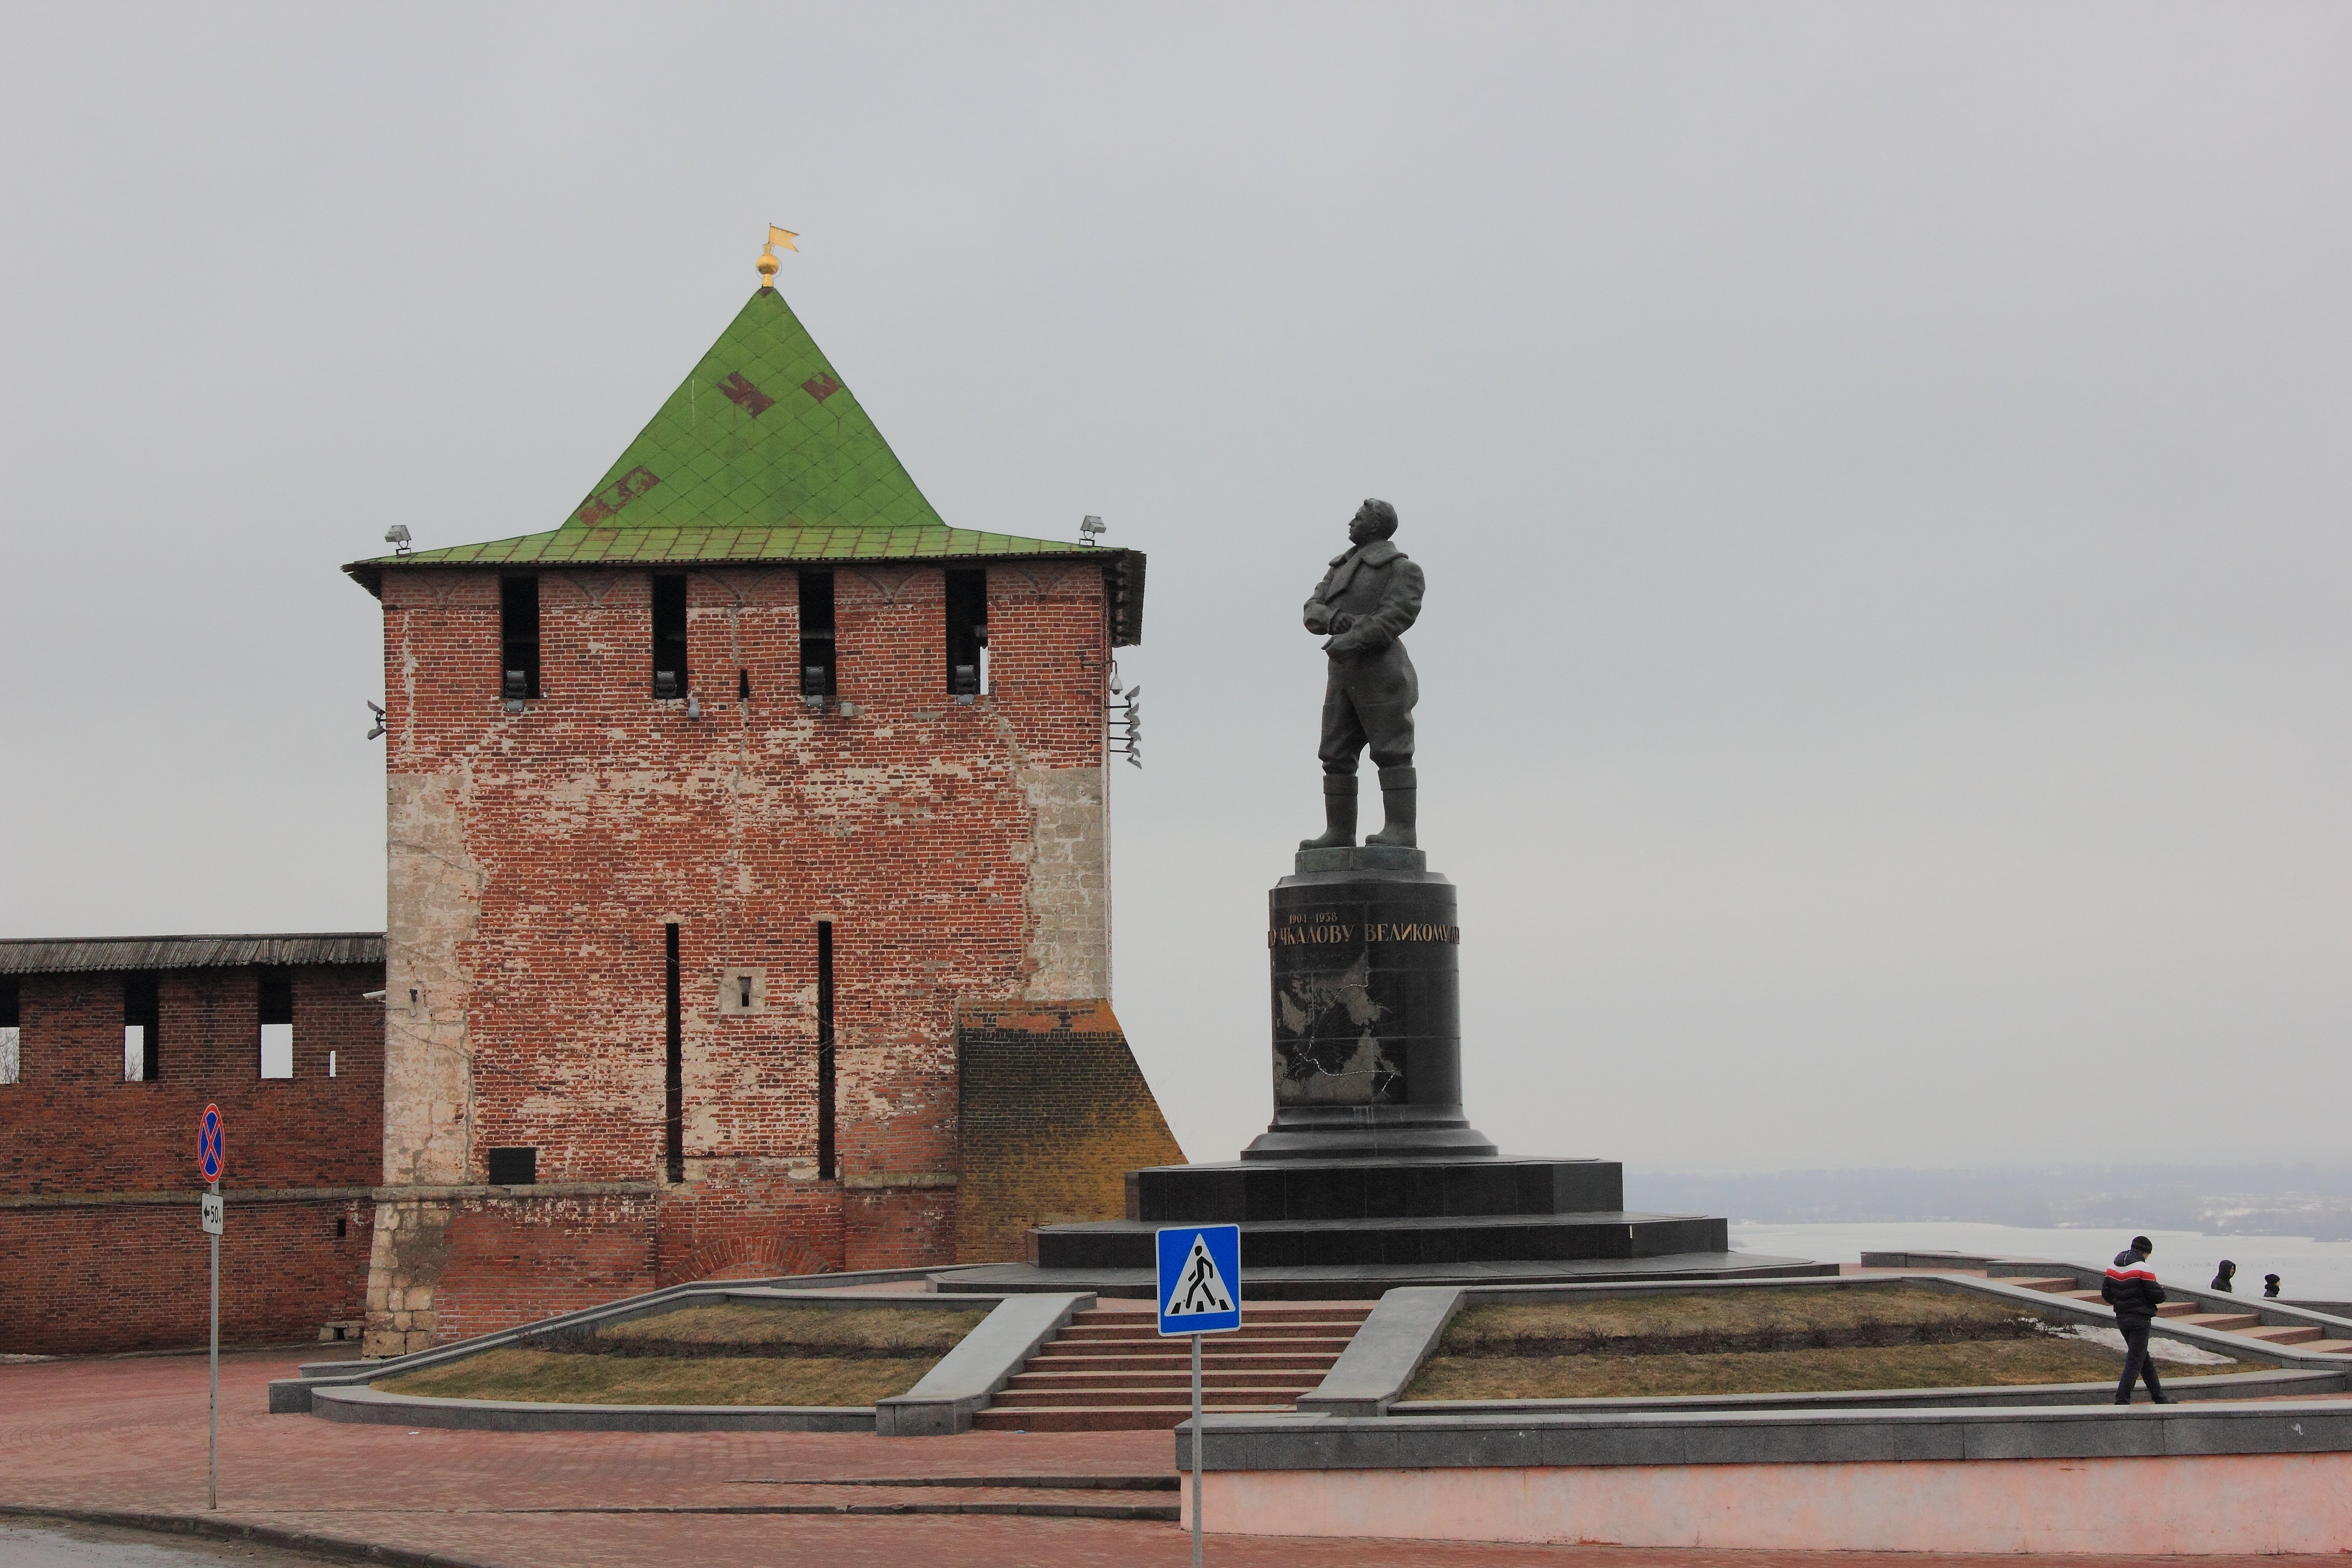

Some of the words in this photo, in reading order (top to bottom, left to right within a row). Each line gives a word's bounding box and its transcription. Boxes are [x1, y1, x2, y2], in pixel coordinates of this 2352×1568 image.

[1280, 924, 1354, 946] ЧКАЛОВУ
[1364, 923, 1449, 942] ВЕЛИКОМУ
[211, 1205, 219, 1224] 50
